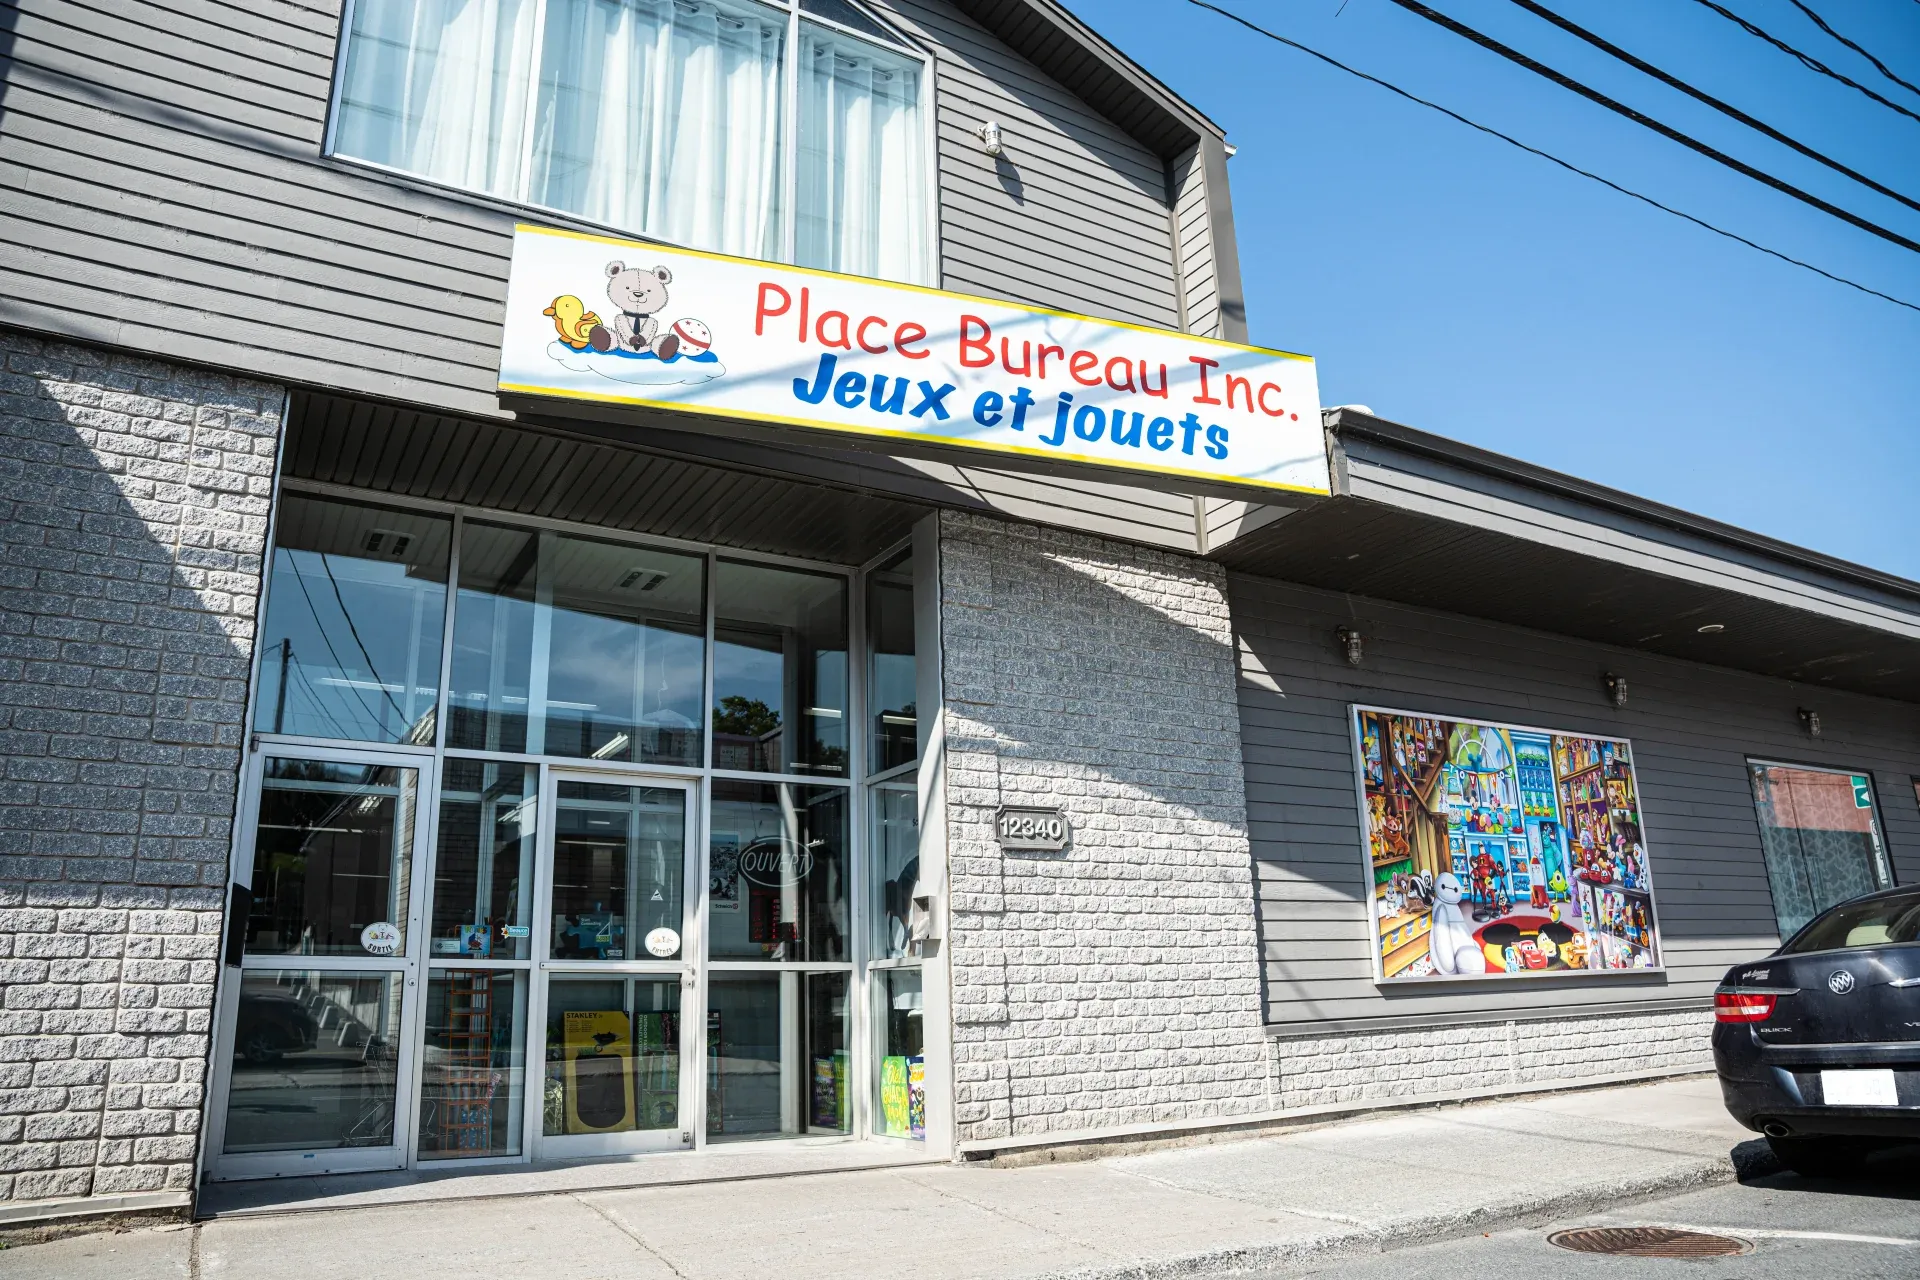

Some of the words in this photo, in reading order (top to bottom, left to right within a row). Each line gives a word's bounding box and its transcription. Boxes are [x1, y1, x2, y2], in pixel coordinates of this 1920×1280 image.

[755, 282, 931, 360] Place
[959, 314, 1169, 399] Bureau
[1188, 355, 1298, 421] Inc.
[793, 353, 955, 421] Jeux
[973, 386, 1036, 432] et
[1038, 391, 1230, 462] jouets
[1000, 817, 1061, 838] 12340
[744, 852, 809, 874] OUVERT
[367, 943, 393, 953] SORTIE
